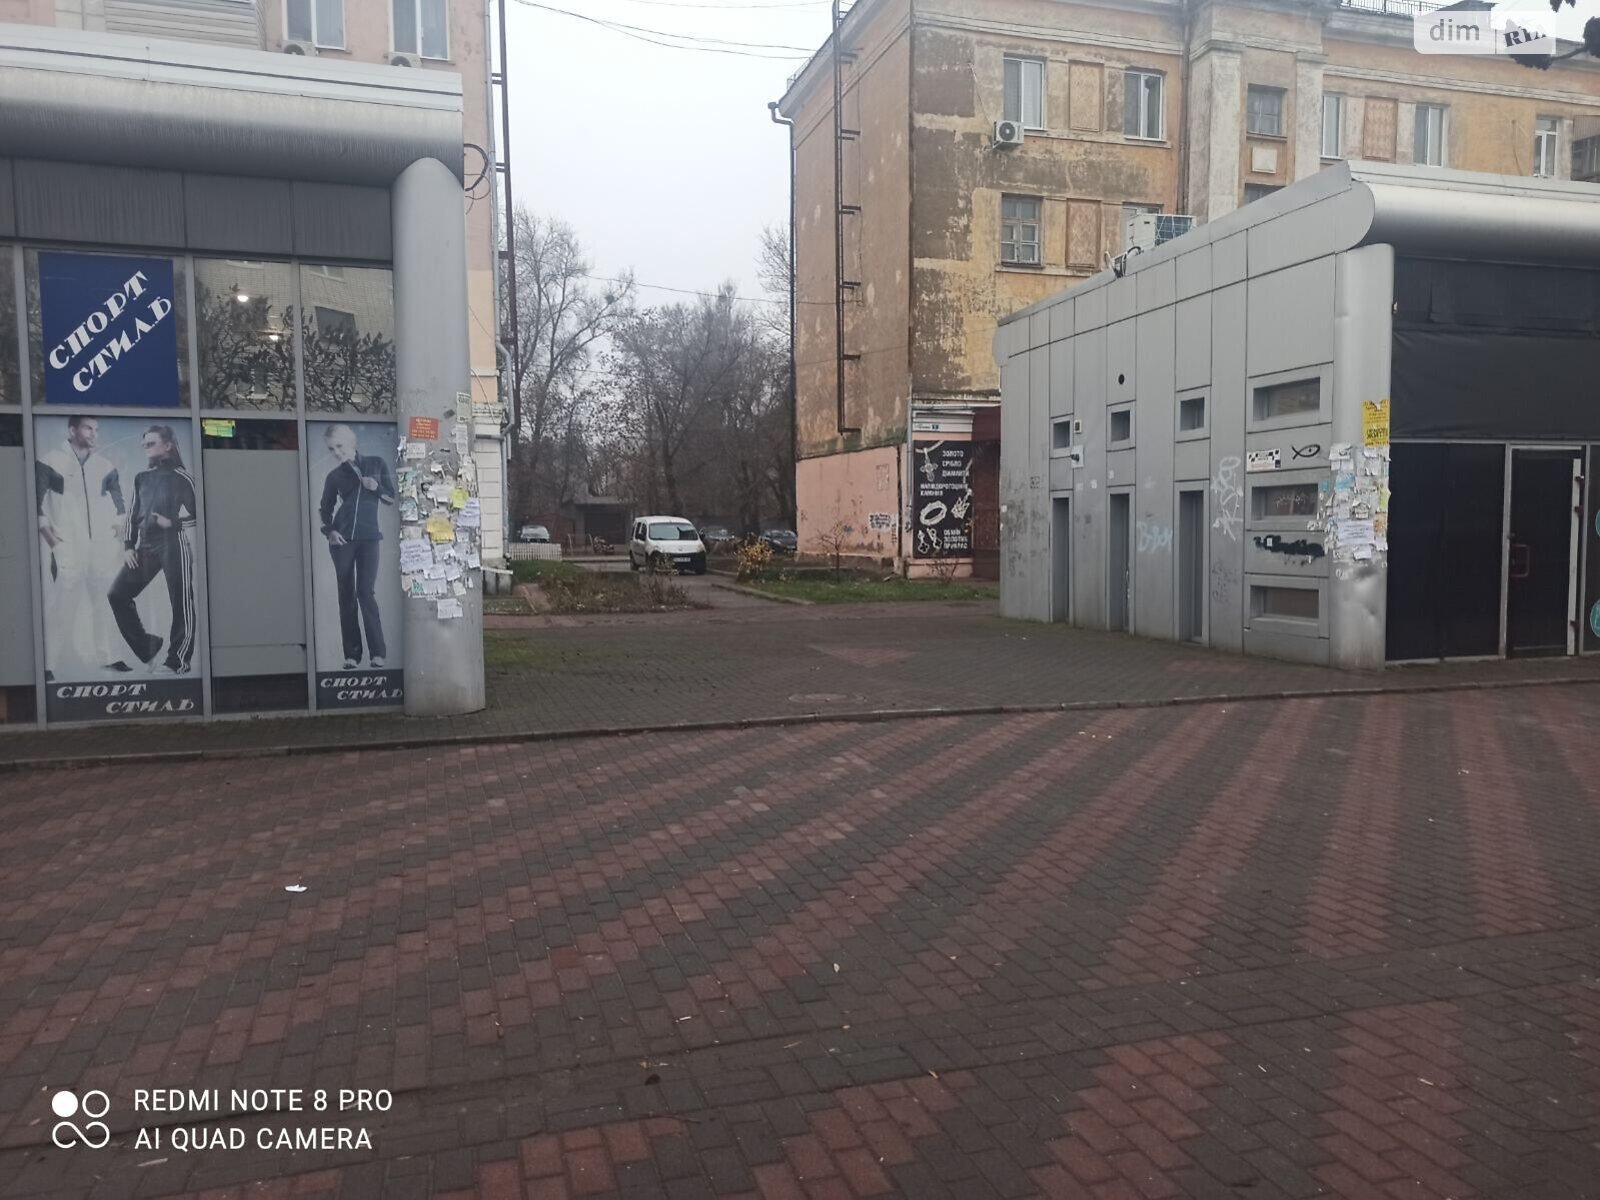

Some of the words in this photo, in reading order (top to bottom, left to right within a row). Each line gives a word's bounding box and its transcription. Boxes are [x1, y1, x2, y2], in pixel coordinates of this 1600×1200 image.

[49, 270, 149, 370] СПОРТ
[72, 296, 172, 392] СТИЛЬ
[320, 676, 387, 688] СПОРТ
[56, 683, 147, 698] СПОРТ
[337, 688, 403, 700] СТИЛЬ
[106, 699, 195, 714] СТИЛЬ
